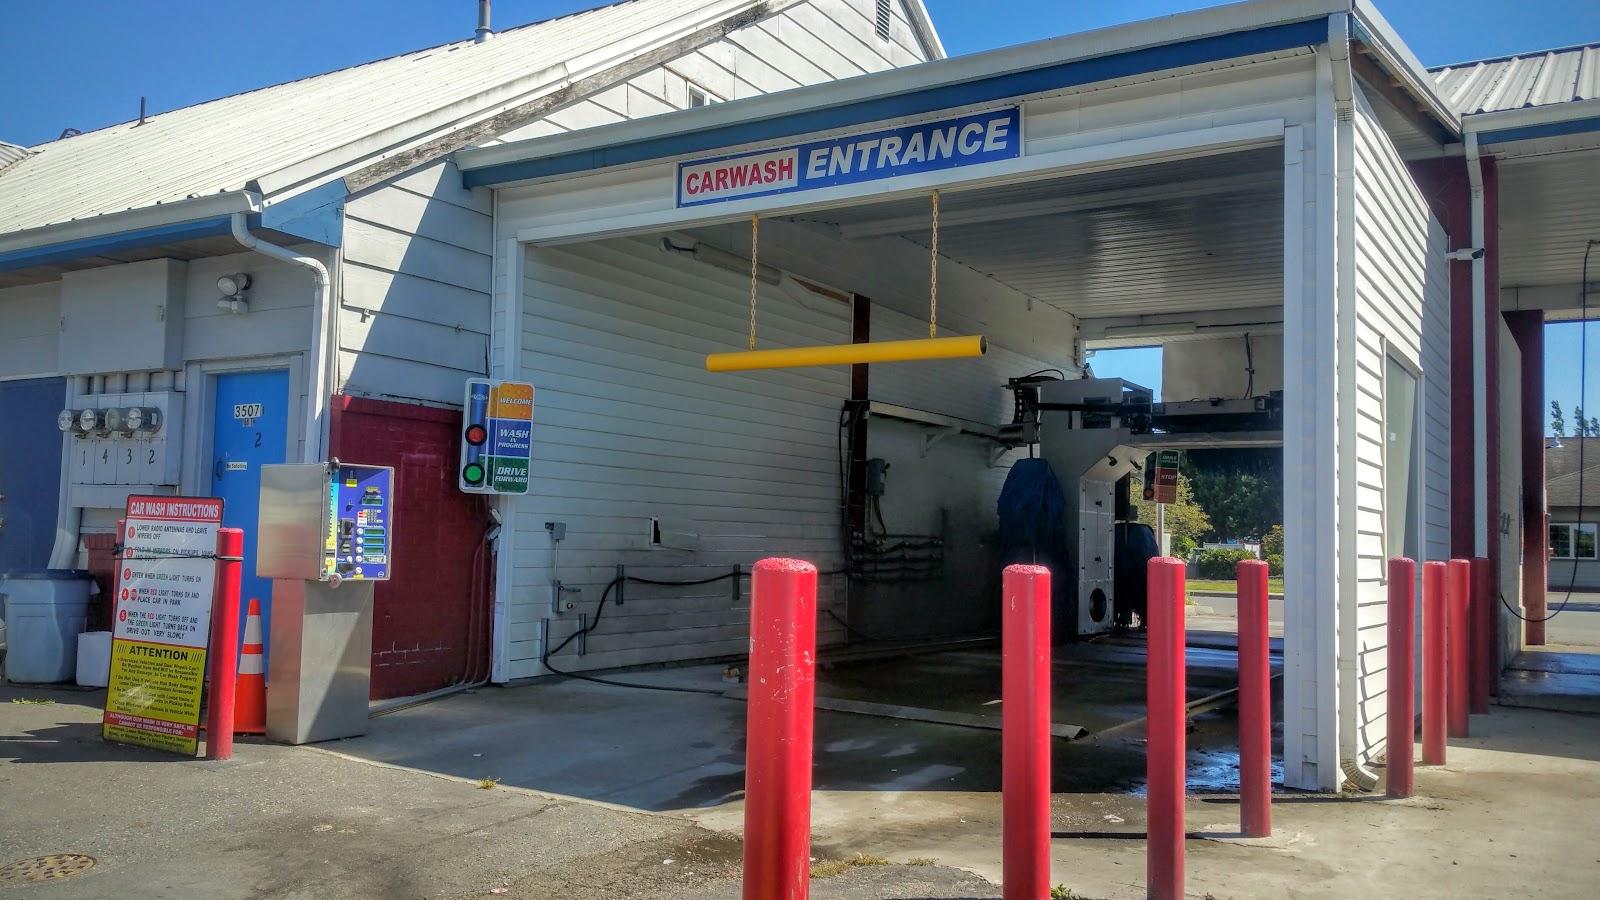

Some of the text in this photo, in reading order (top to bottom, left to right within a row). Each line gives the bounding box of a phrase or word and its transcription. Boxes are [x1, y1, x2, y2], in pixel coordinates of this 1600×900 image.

[685, 116, 1011, 195] CARWASH ENTRANCE
[500, 396, 533, 406] WELCOME
[235, 405, 260, 418] 3507
[255, 432, 262, 448] 2
[500, 429, 529, 439] WASH
[102, 449, 109, 465] 4
[126, 448, 133, 465] 3
[148, 449, 155, 465] 2
[496, 466, 528, 476] DRIVE
[495, 475, 528, 484] FORWARD
[130, 502, 219, 518] CAR WASH INSTRUCTIONS
[129, 646, 188, 661] ATTENTION
